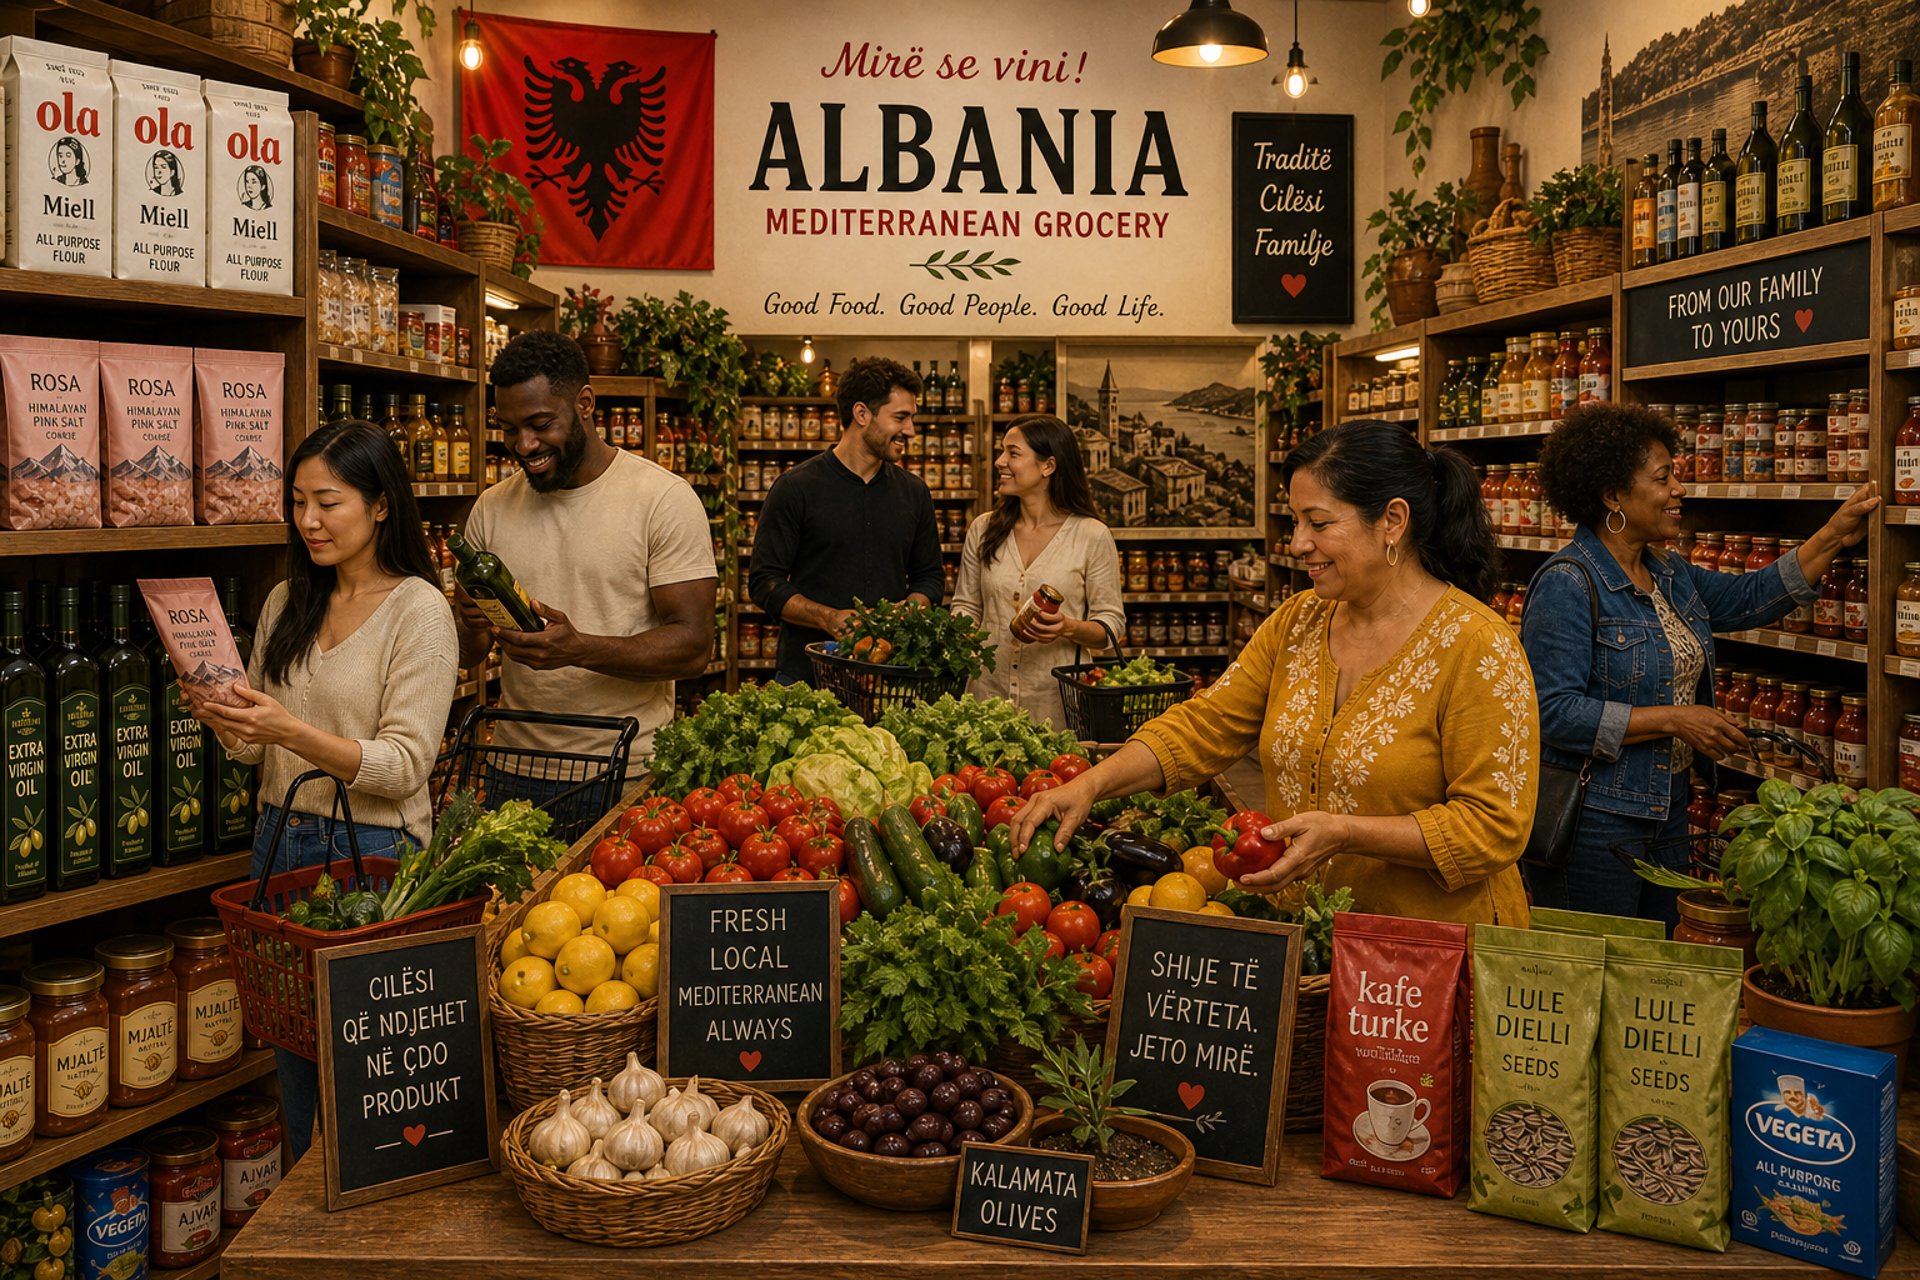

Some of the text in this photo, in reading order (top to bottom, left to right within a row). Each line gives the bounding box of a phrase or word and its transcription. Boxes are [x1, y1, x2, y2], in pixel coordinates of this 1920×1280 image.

[820, 41, 1089, 84] Mirë se vini!
[36, 91, 101, 138] ola
[134, 106, 194, 151] ola
[227, 124, 282, 165] ola
[748, 101, 1189, 196] ALBANIA
[1253, 141, 1332, 171] Traditë
[43, 194, 96, 220] Miell
[1259, 183, 1325, 212] Cilësi
[139, 204, 190, 229] Miell
[232, 217, 278, 241] Miell
[765, 207, 1170, 239] MEDITERRANEAN GROCERY
[36, 232, 101, 250] ALL PURPOSE
[133, 242, 195, 259] ALL PURPOSE
[1254, 228, 1334, 266] Familje
[53, 249, 86, 264] FLOUR
[149, 258, 180, 273] FLOUR
[226, 253, 283, 269] ALL PURPOSE
[240, 269, 269, 282] FLOUR
[1668, 266, 1824, 320] FROM OUR FAMILY
[764, 291, 1164, 324] Good Food. Good People. Good Life.
[1691, 312, 1781, 350] TO YOURS
[30, 373, 82, 393] ROSA
[128, 378, 176, 397] ROSA
[222, 382, 267, 400] ROSA
[28, 402, 87, 414] HIMALAYAN
[126, 405, 181, 417] HIMALAYAN
[33, 416, 84, 428] PINK SALT
[131, 418, 155, 429] PINK
[168, 608, 210, 625] ROSA
[116, 724, 149, 743] EXTRA
[170, 718, 201, 735] EXTRA
[8, 740, 45, 761] EXTRA
[64, 732, 97, 751] EXTRA
[116, 742, 149, 761] VIRGIN
[170, 734, 201, 752] VIRGIN
[8, 760, 44, 780] VIRGIN
[64, 750, 97, 769] VIRGIN
[122, 760, 144, 778] OIL
[176, 752, 197, 769] OIL
[15, 778, 39, 798] OIL
[70, 769, 92, 788] OIL
[710, 907, 787, 933] FRESH
[710, 945, 789, 971] LOCAL
[1151, 951, 1260, 990] SHIJE TË
[368, 966, 434, 1001] CILËSI
[678, 982, 823, 1007] MEDITERRANEAN
[1357, 970, 1423, 1009] kafe
[1147, 989, 1258, 1033] VËRTETA.
[1505, 986, 1565, 1015] LULE
[1634, 996, 1696, 1027] LULE
[343, 1000, 468, 1045] QË NDJEHET
[705, 1017, 793, 1042] ALWAYS
[1348, 1008, 1429, 1044] turke
[1496, 1014, 1570, 1046] DIELLI
[1130, 1033, 1258, 1077] JETO MIRË.
[1624, 1026, 1702, 1059] DIELLI
[366, 1041, 448, 1079] NË ÇDO
[1502, 1054, 1560, 1080] SEEDS
[1630, 1066, 1690, 1093] SEEDS
[363, 1076, 461, 1119] PRODUKT
[1755, 1112, 1845, 1152] VEGETA
[240, 1159, 277, 1185] AJVAR
[970, 1161, 1078, 1198] KALAMATA
[1755, 1160, 1778, 1176] ALL
[95, 1208, 148, 1240] VEGETA
[178, 1200, 217, 1228] AJVAR
[980, 1199, 1058, 1233] OLIVES
